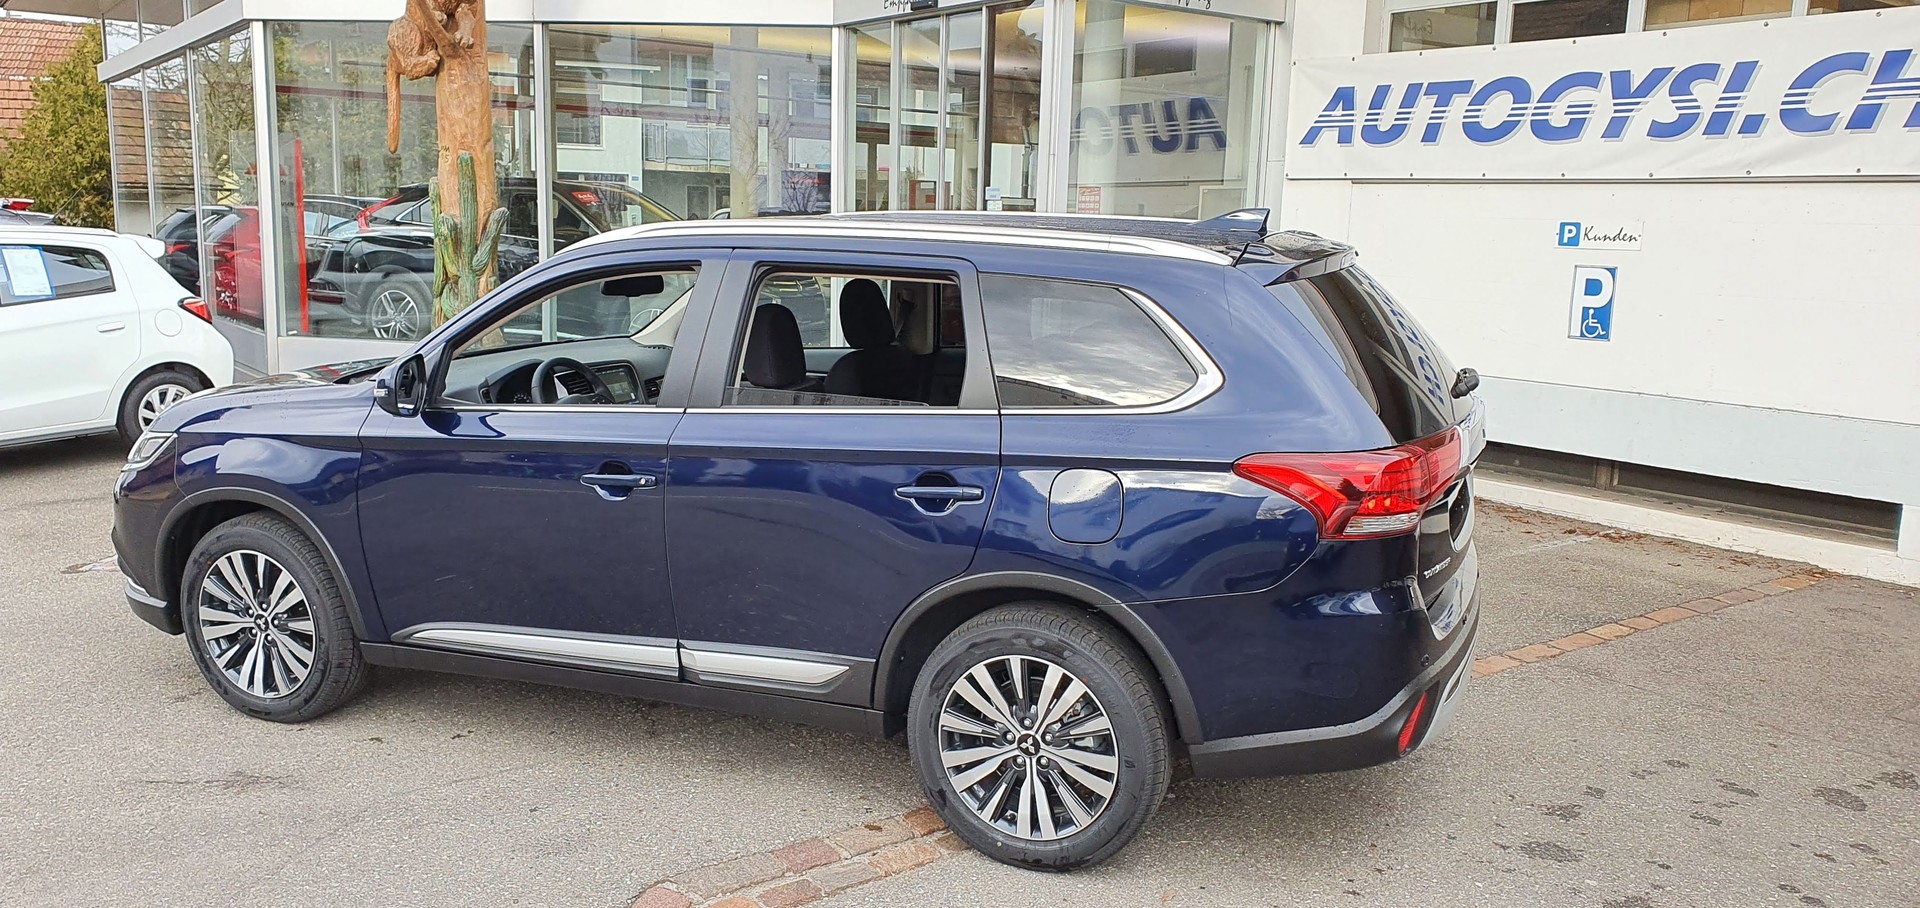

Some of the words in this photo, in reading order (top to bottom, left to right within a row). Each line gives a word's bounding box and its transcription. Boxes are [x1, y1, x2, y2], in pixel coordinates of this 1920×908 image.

[1563, 225, 1577, 243] P
[1583, 225, 1638, 242] Kunden
[1570, 267, 1614, 337] P
